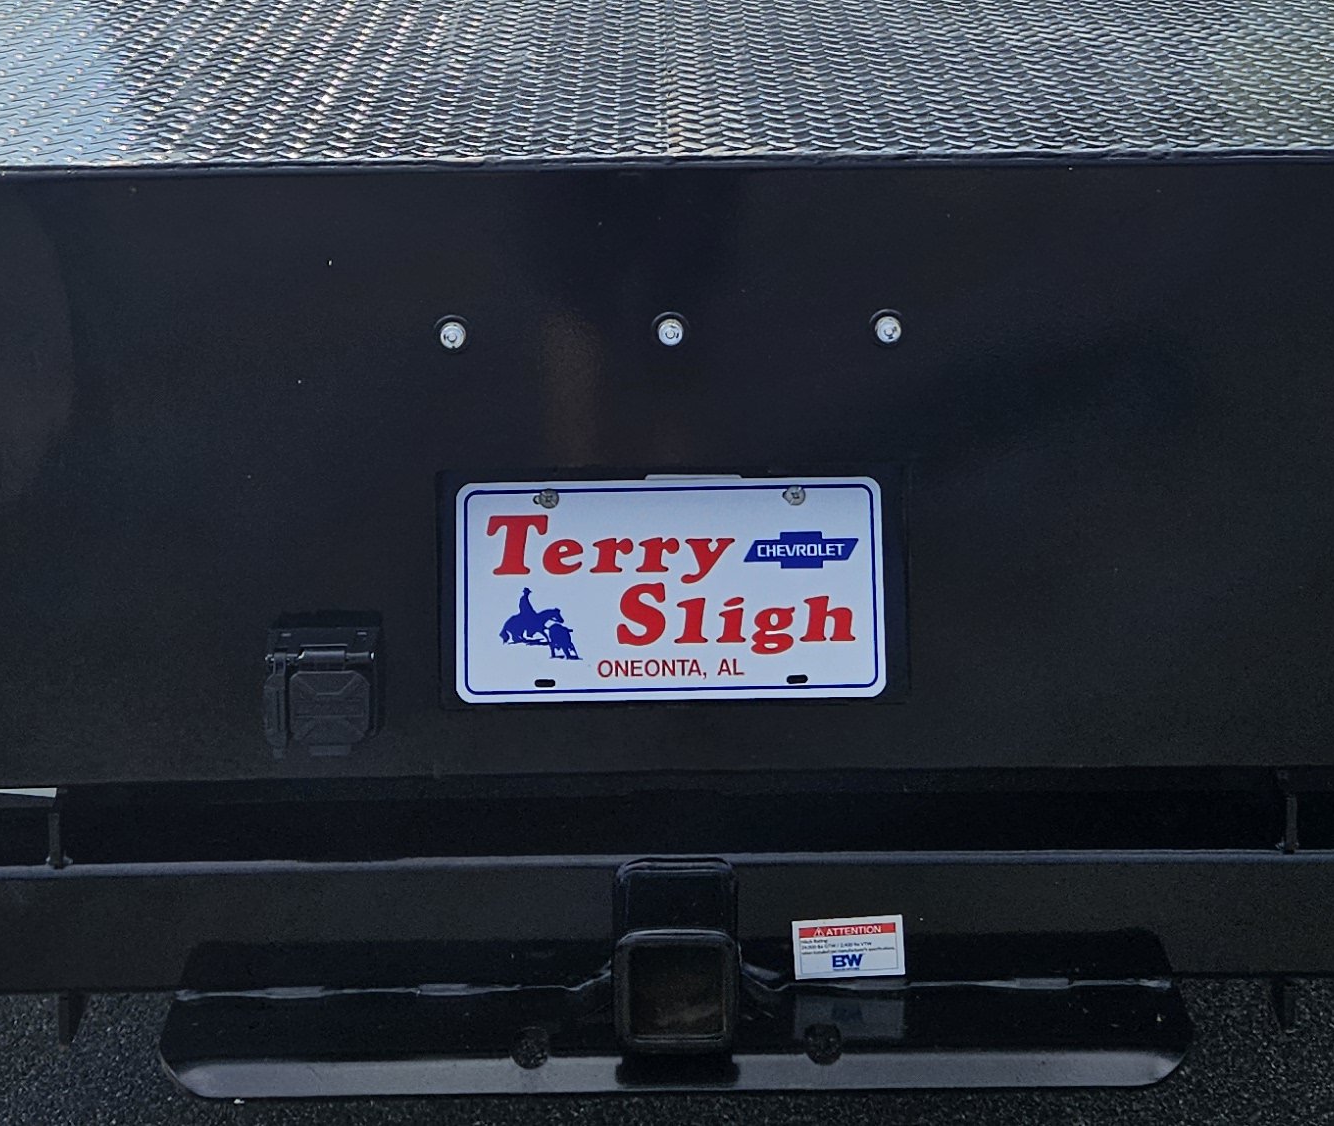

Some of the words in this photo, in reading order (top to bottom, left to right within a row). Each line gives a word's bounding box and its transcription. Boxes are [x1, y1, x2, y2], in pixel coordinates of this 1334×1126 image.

[486, 515, 736, 584] Terry
[755, 542, 846, 559] CHEVROLET
[616, 582, 857, 655] Sligh
[596, 659, 708, 679] ONEONTA,
[717, 658, 746, 676] AL
[826, 925, 882, 937] ATTENTION
